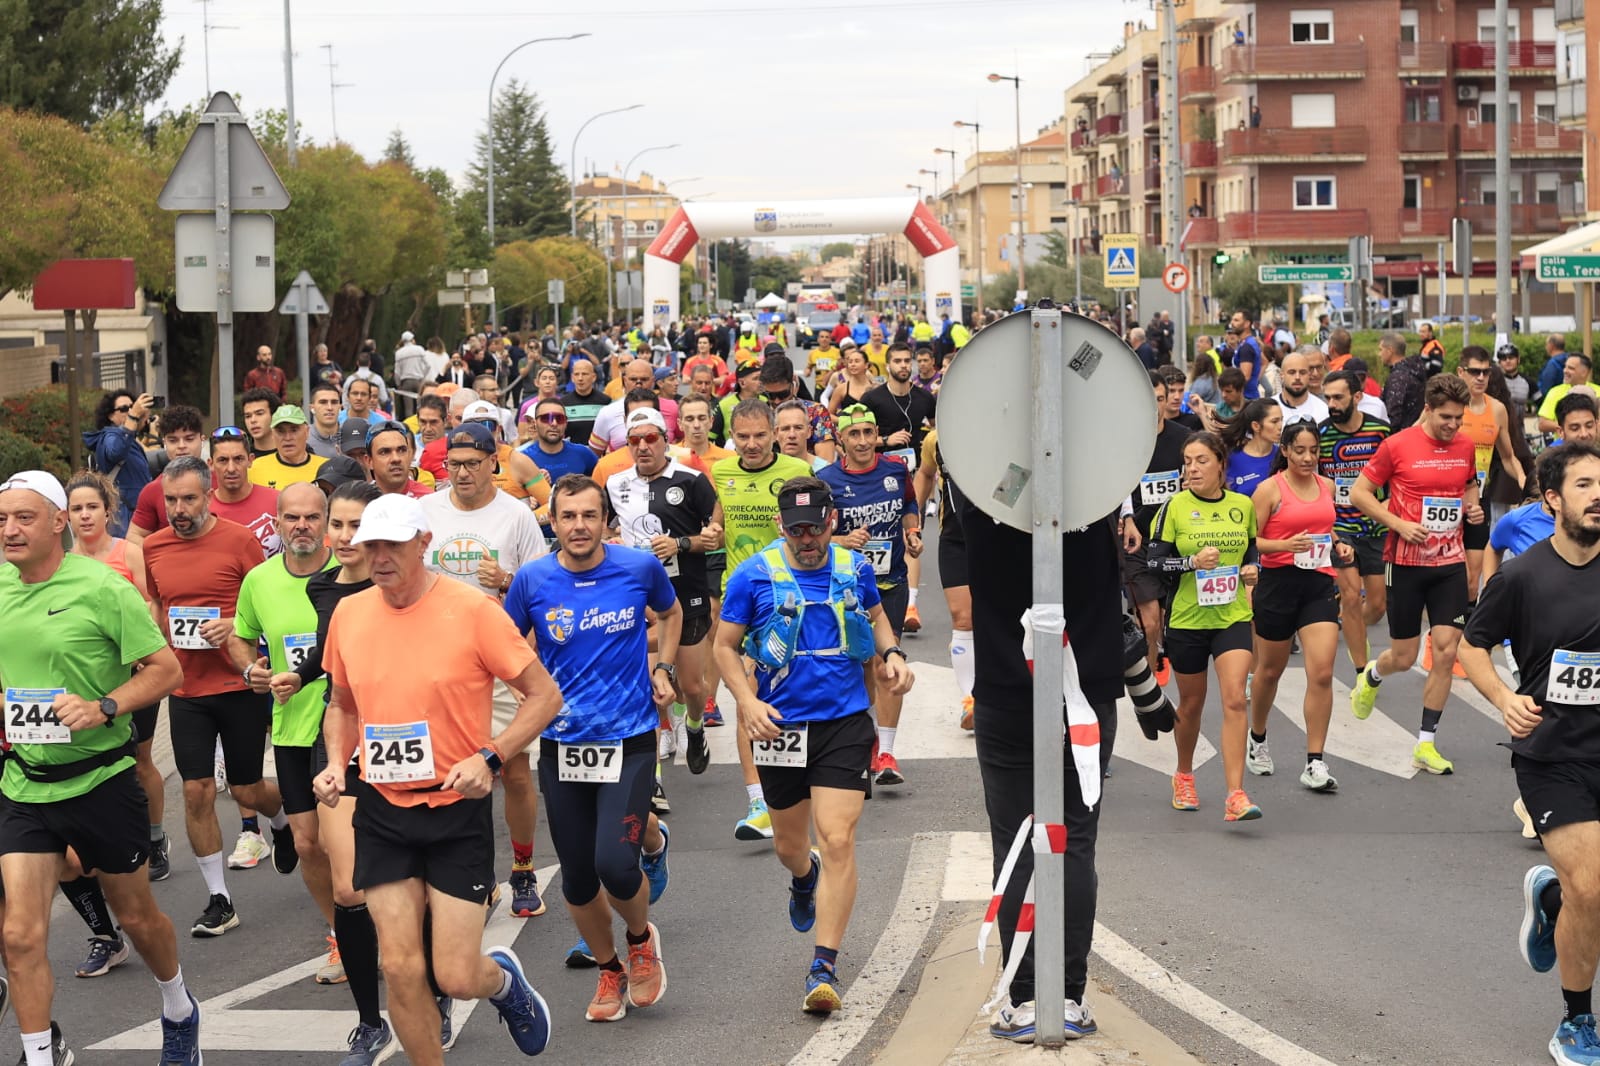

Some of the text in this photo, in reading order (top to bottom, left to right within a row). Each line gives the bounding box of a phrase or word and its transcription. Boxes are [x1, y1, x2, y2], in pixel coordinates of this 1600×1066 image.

[1542, 257, 1566, 265] calle
[1288, 272, 1300, 280] del
[1301, 272, 1329, 280] Carmen
[1543, 265, 1569, 276] Sta.
[1345, 443, 1372, 452] XXXVIII
[1146, 480, 1177, 495] 155
[843, 498, 903, 519] FONDISTAS
[1426, 507, 1459, 522] 505
[853, 511, 897, 528] MADRID
[1196, 539, 1246, 548] CARBAJOSA
[1202, 576, 1237, 594] 450
[579, 605, 635, 631] CABRAS
[583, 606, 599, 617] LAS
[174, 619, 211, 637] 27
[604, 619, 636, 635] AZULES
[10, 704, 61, 727] 244
[759, 731, 802, 753] 552
[369, 738, 424, 767] 245
[565, 747, 616, 768] 507
